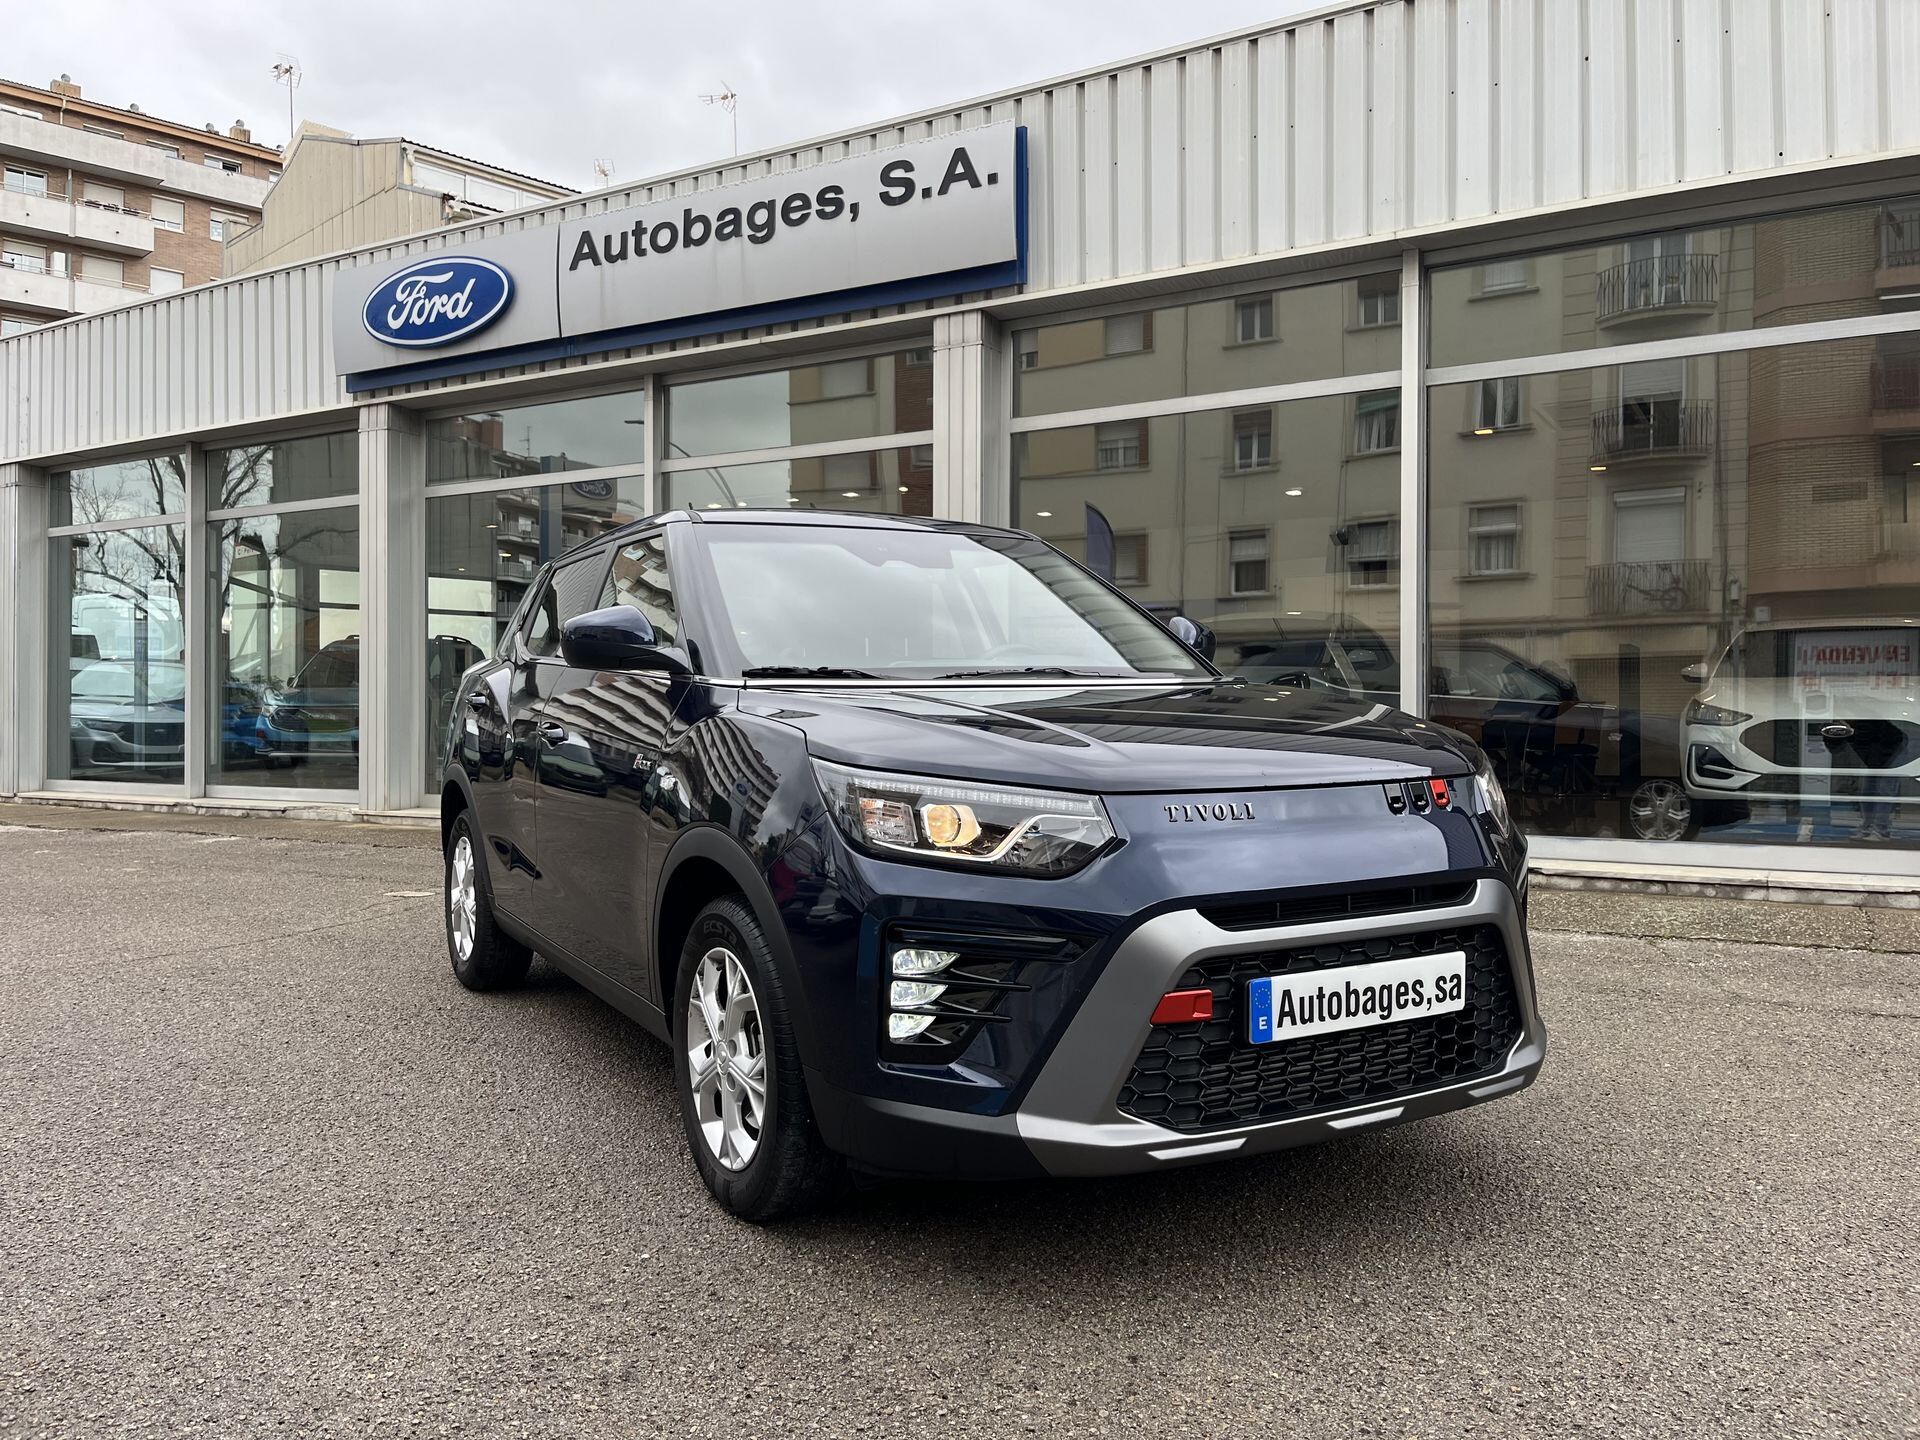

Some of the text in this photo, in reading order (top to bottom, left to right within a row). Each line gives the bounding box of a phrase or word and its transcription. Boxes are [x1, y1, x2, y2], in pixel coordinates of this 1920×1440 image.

[569, 147, 999, 272] Autobages, S.A.
[387, 271, 476, 329] Ford
[1163, 802, 1256, 822] TIVOLI
[1259, 1016, 1268, 1030] E
[1277, 973, 1462, 1028] Autobages,sa
